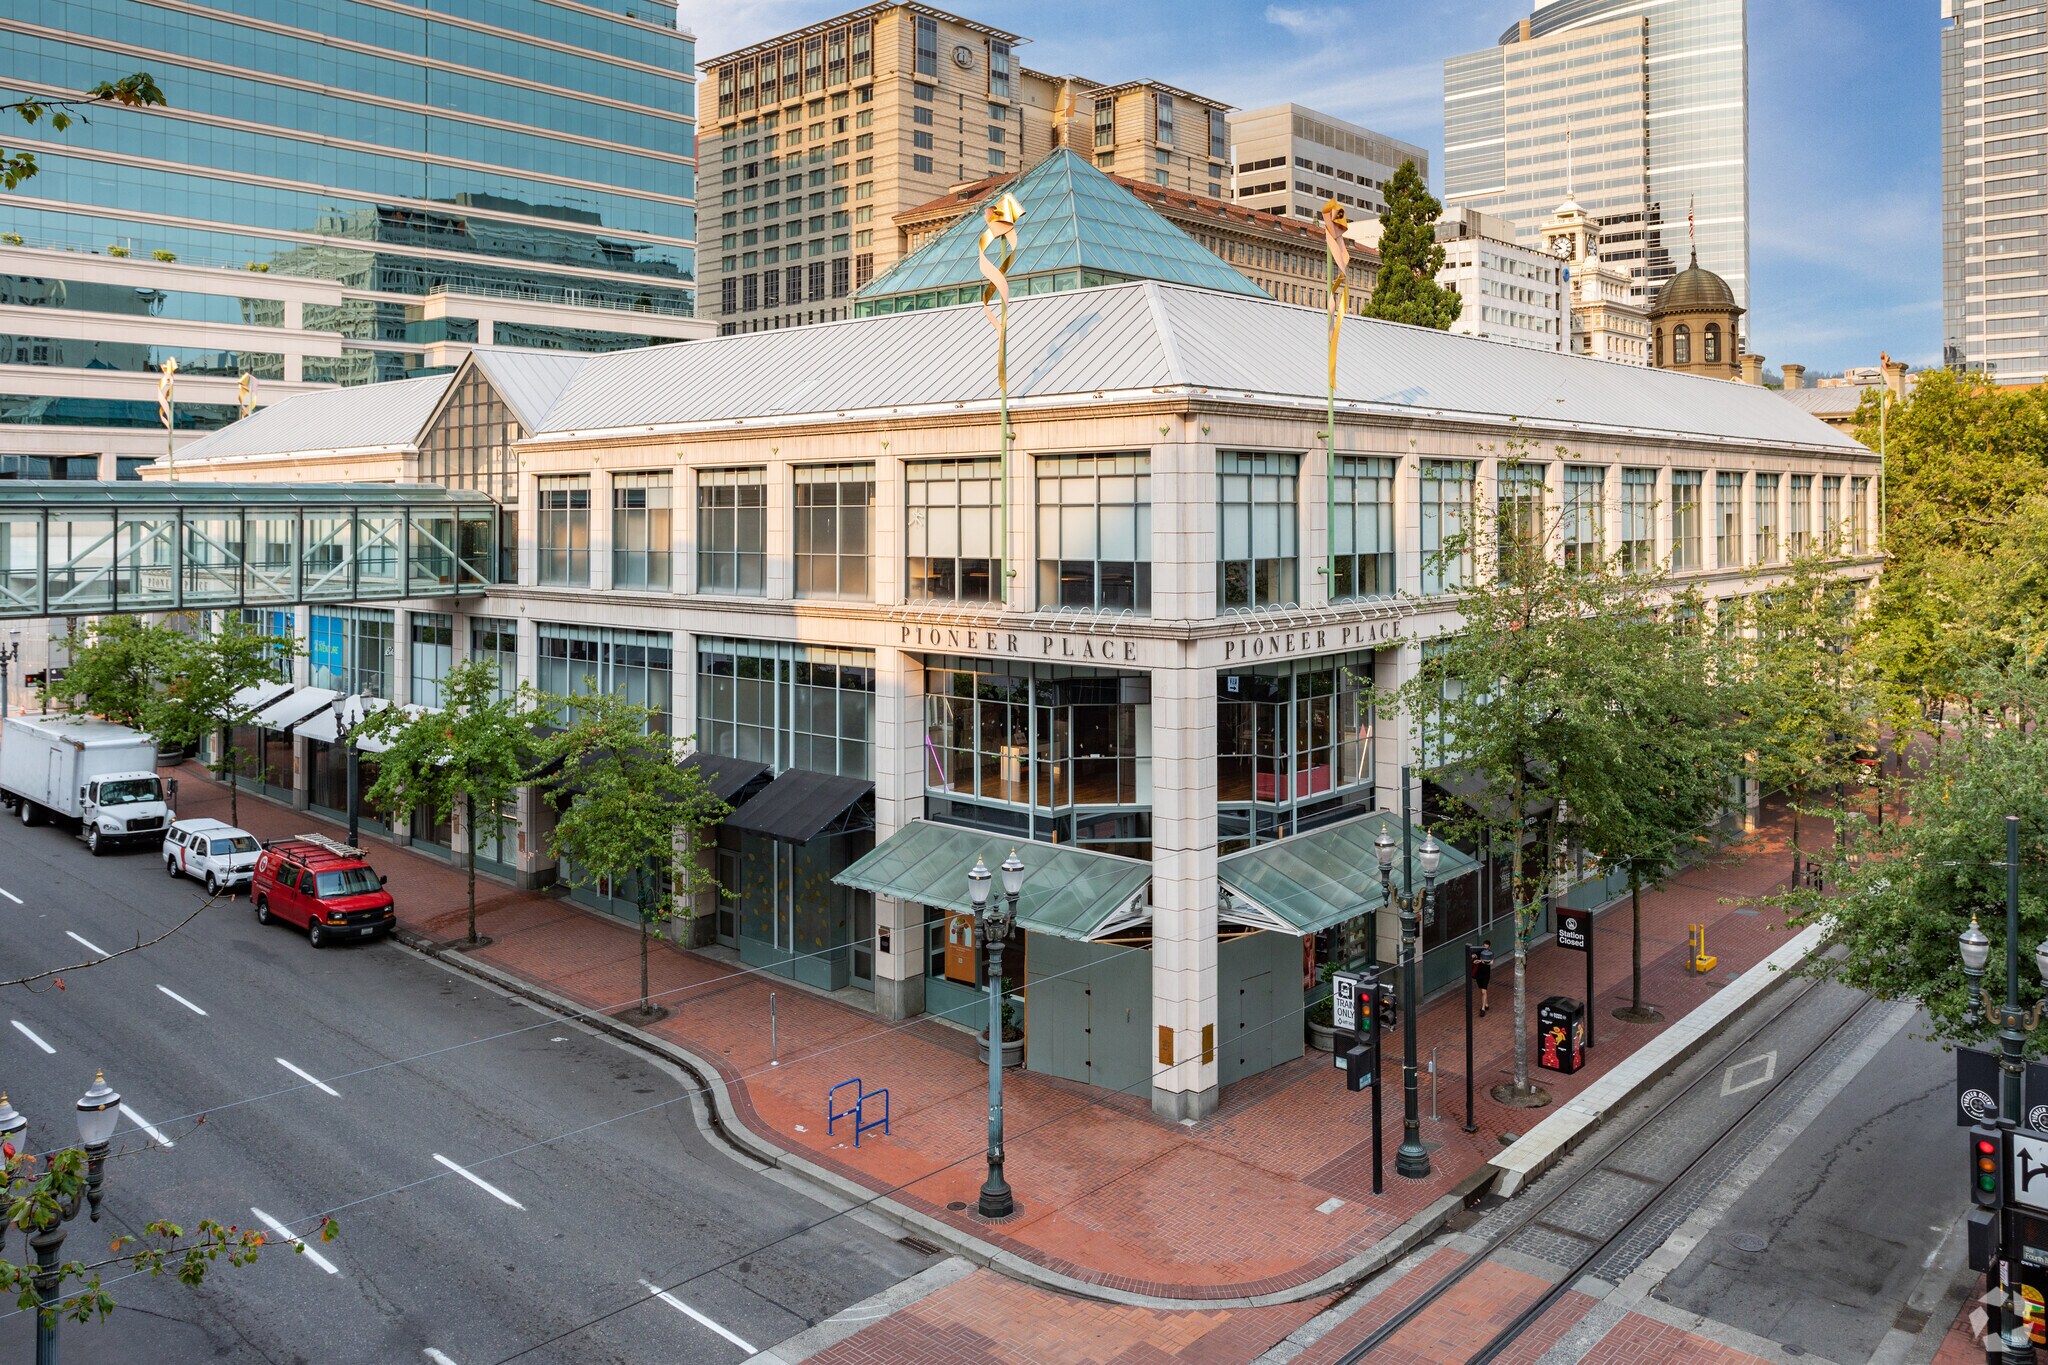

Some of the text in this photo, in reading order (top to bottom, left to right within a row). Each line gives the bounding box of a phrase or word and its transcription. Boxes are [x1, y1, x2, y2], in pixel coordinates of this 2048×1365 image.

[148, 577, 169, 588] PIONE
[901, 626, 1136, 661] PIONEER PLACE
[1225, 621, 1401, 660] PIONEER PLACE
[1559, 929, 1584, 940] Station
[1559, 937, 1584, 948] Closed
[1337, 998, 1354, 1010] TRAIN
[1337, 1008, 1355, 1019] ONLY
[2025, 1252, 2044, 1263] Fourth
